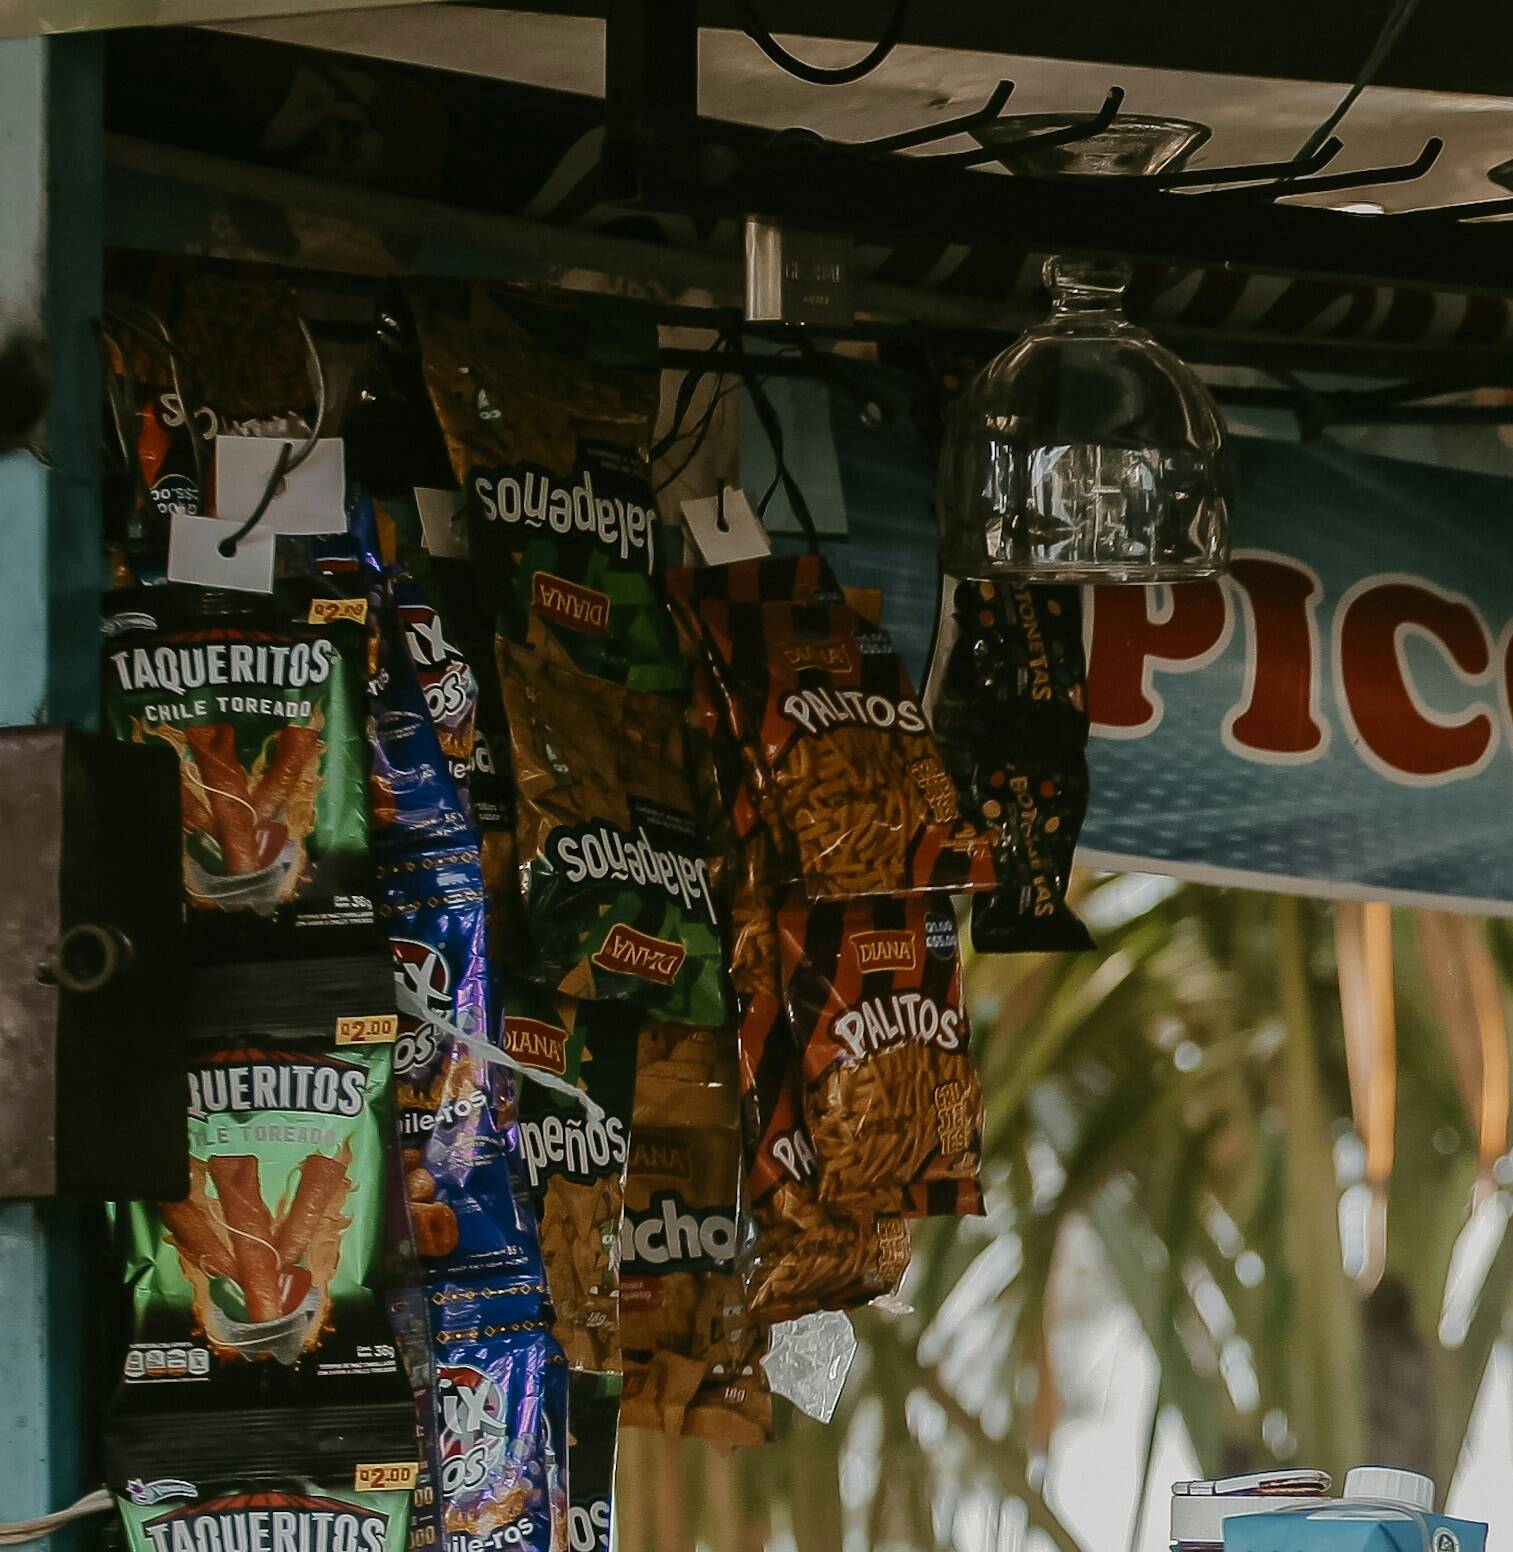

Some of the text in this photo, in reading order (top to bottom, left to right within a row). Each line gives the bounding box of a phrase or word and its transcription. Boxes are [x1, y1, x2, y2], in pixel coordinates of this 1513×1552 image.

[538, 583, 605, 626] DIANA
[111, 639, 334, 696] TAQUERITOS
[145, 696, 311, 722] CHILE TOREADO
[784, 688, 925, 733] PALITOS
[611, 934, 679, 975] DIANA
[861, 938, 911, 962] DIANA
[341, 1020, 392, 1042] Q2.00
[835, 993, 959, 1056] PALITOS
[360, 1467, 411, 1488] Q2.00
